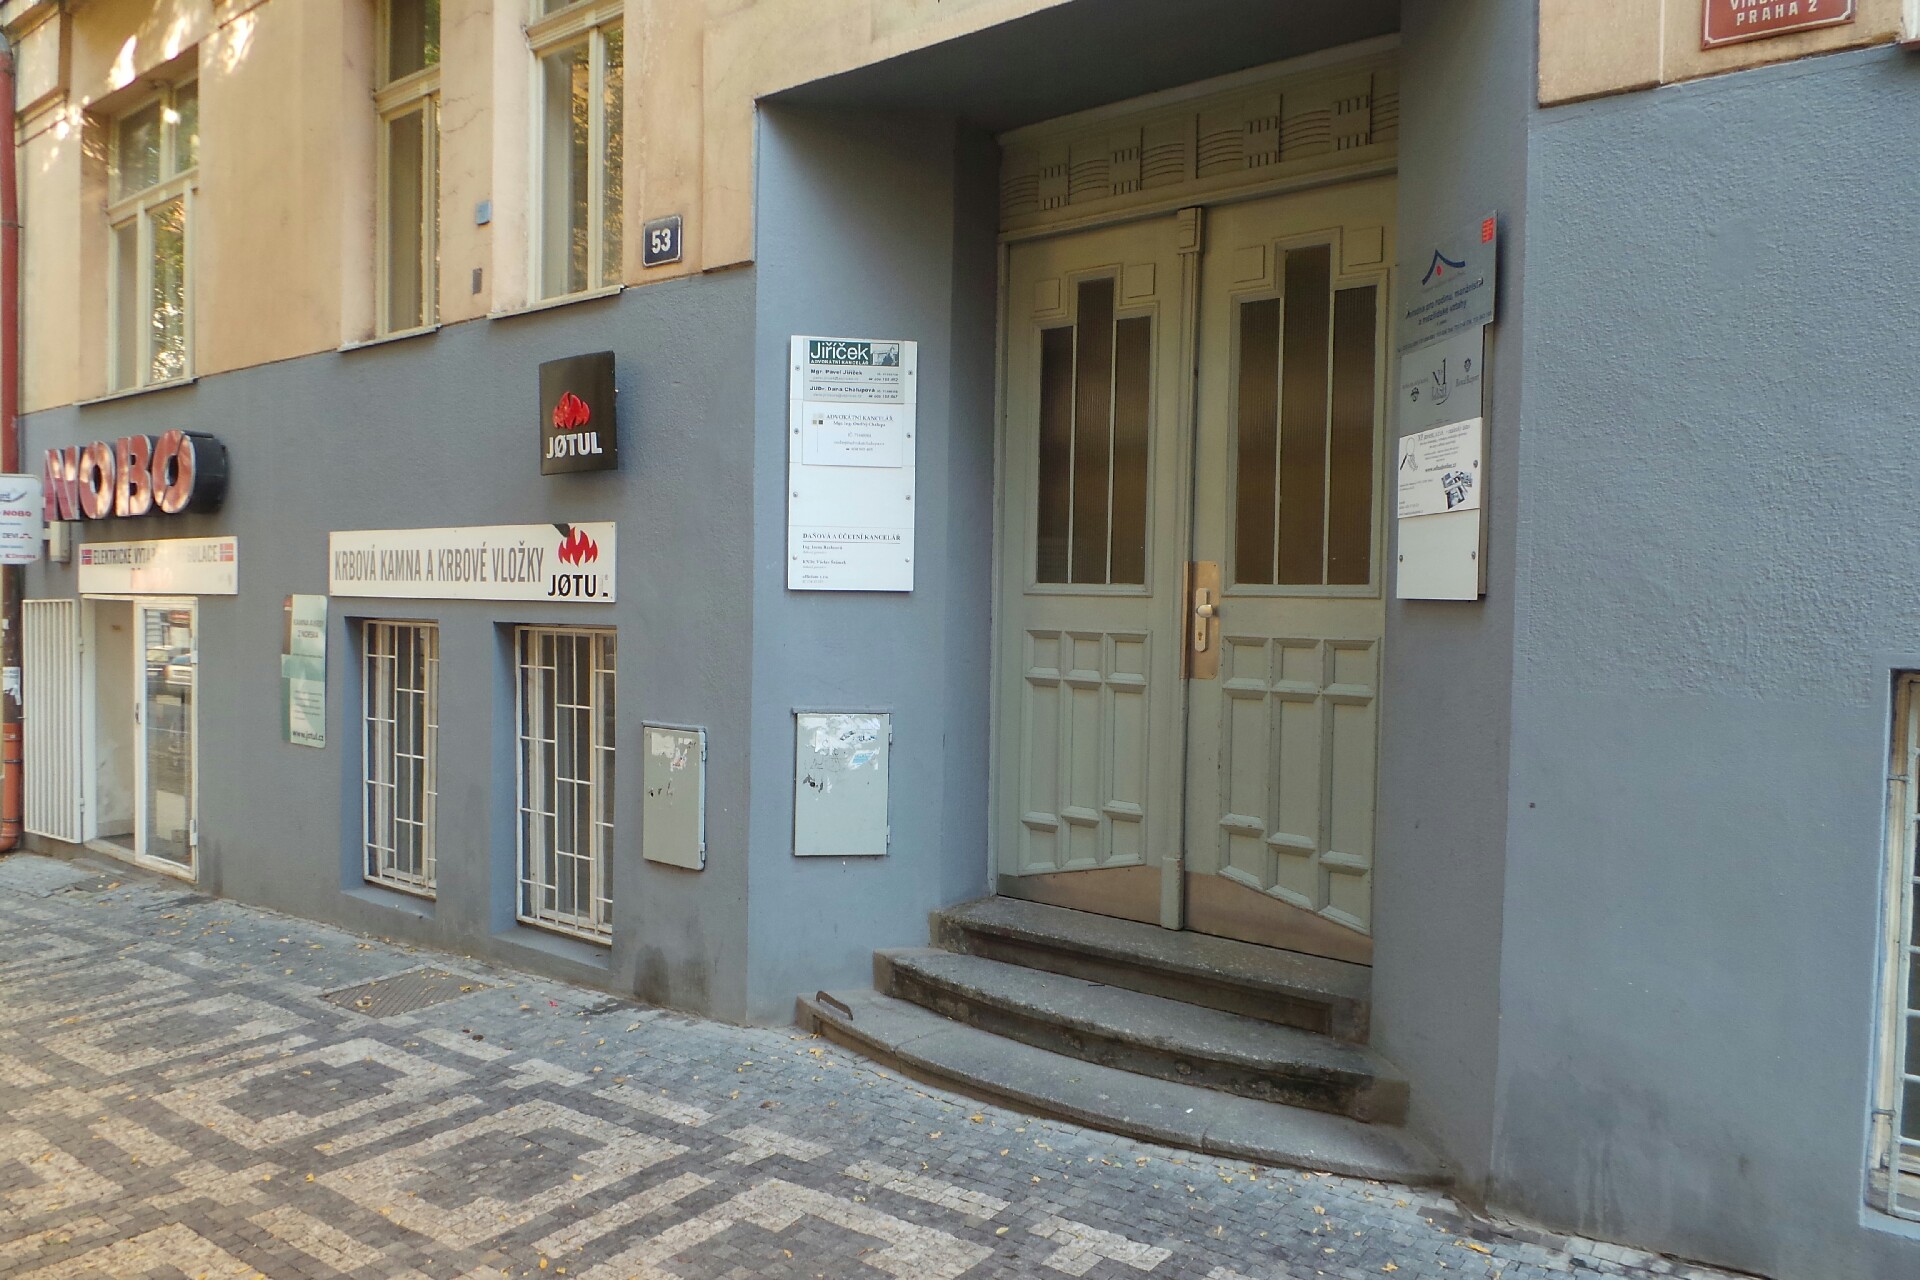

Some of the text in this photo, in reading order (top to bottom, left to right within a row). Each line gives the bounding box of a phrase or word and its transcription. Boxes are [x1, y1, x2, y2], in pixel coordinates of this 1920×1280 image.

[1736, 0, 1818, 26] PRAHA 2
[651, 228, 671, 254] 53
[810, 341, 869, 361] Jiříček
[546, 431, 603, 459] JØTUL
[43, 428, 195, 521] NOBO
[93, 545, 132, 565] ELEKTRICKÉ
[335, 540, 544, 583] KRBOVÁ KAMNA A KRBOVÉ VLOŽKY
